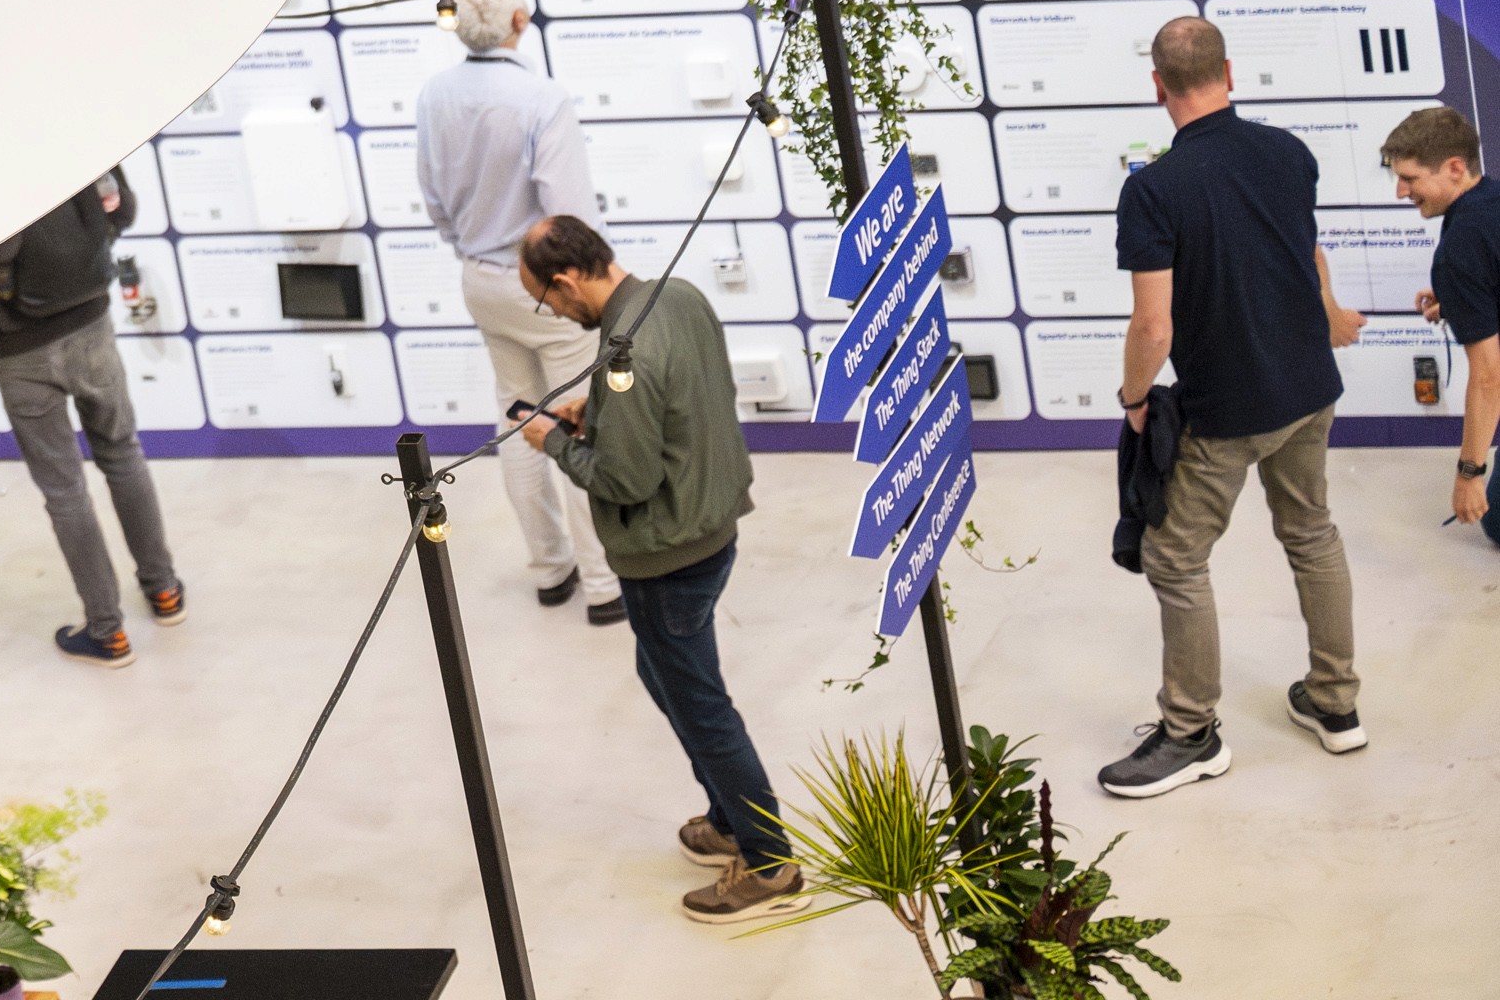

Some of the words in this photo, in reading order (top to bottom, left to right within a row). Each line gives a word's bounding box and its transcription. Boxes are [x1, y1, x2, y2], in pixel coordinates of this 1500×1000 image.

[853, 215, 882, 266] We
[880, 184, 905, 233] are
[1342, 239, 1404, 248] Conference
[843, 342, 864, 378] the
[862, 273, 906, 351] company
[904, 216, 939, 285] behind
[874, 395, 896, 432] The
[891, 356, 920, 405] Thing
[916, 317, 941, 368] Stack
[872, 490, 895, 527] The
[891, 449, 923, 500] Thing
[919, 389, 961, 462] Network
[894, 573, 913, 608] The
[909, 532, 935, 582] Thing
[930, 459, 971, 541] Conference
